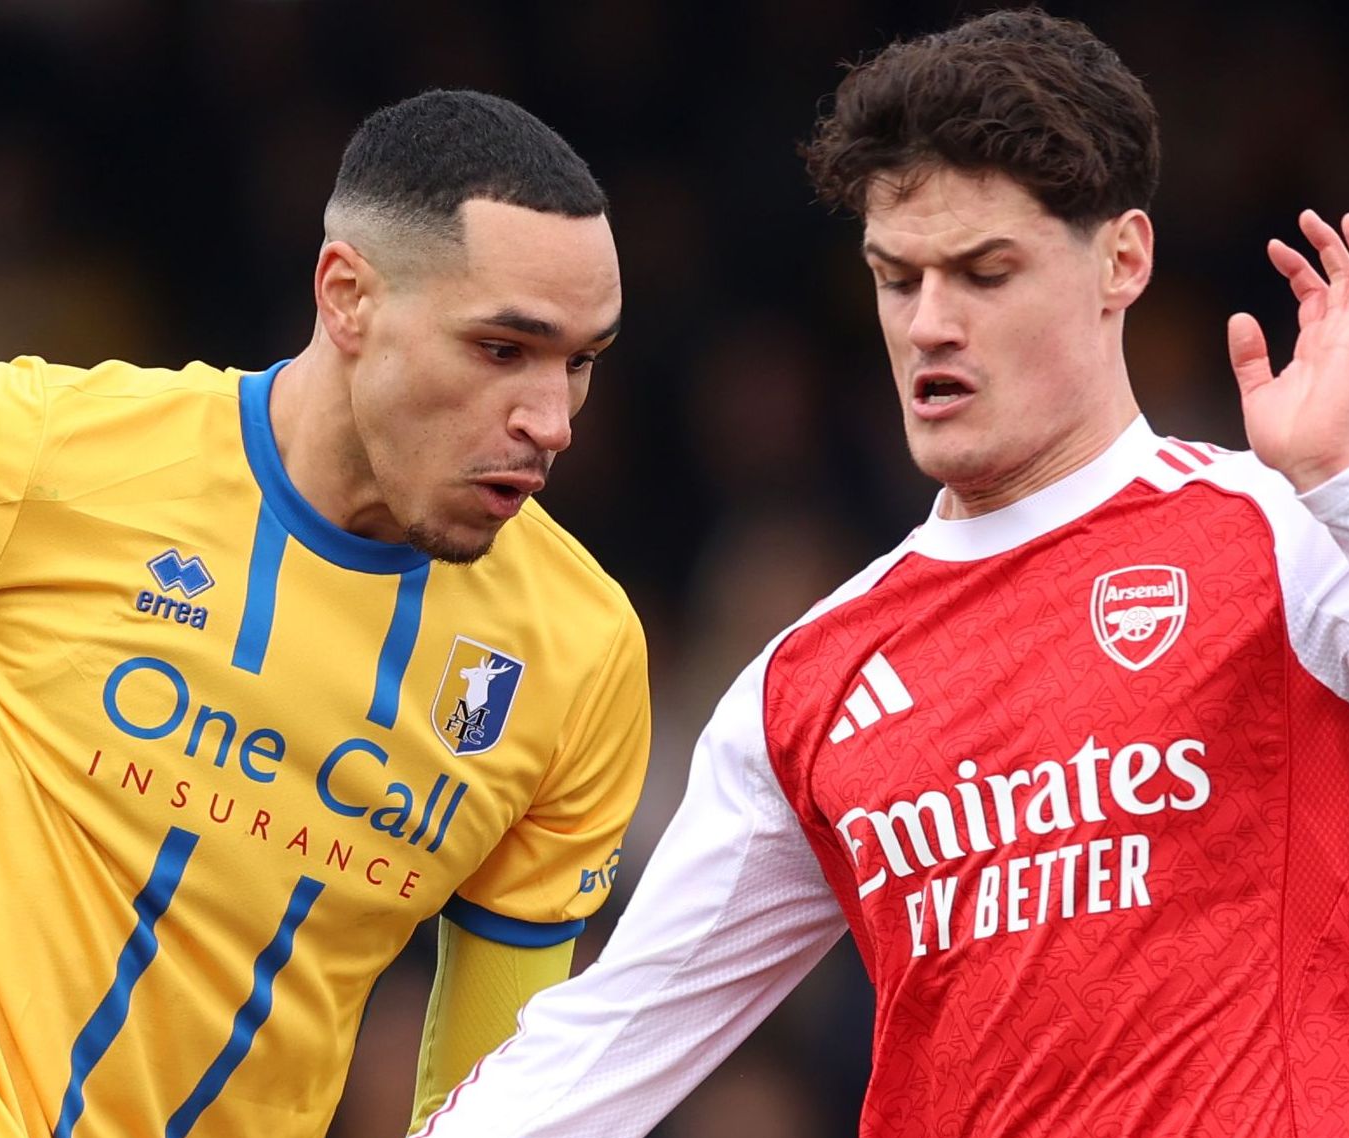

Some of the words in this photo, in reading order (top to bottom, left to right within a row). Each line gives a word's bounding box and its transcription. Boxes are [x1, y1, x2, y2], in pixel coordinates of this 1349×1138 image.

[136, 591, 208, 630] errea
[1104, 581, 1174, 602] Arsenal
[102, 657, 286, 783] One
[316, 738, 469, 853] Call
[836, 735, 1211, 900] Emirates
[88, 750, 421, 899] INSURANCE
[973, 834, 1151, 939] BETTER
